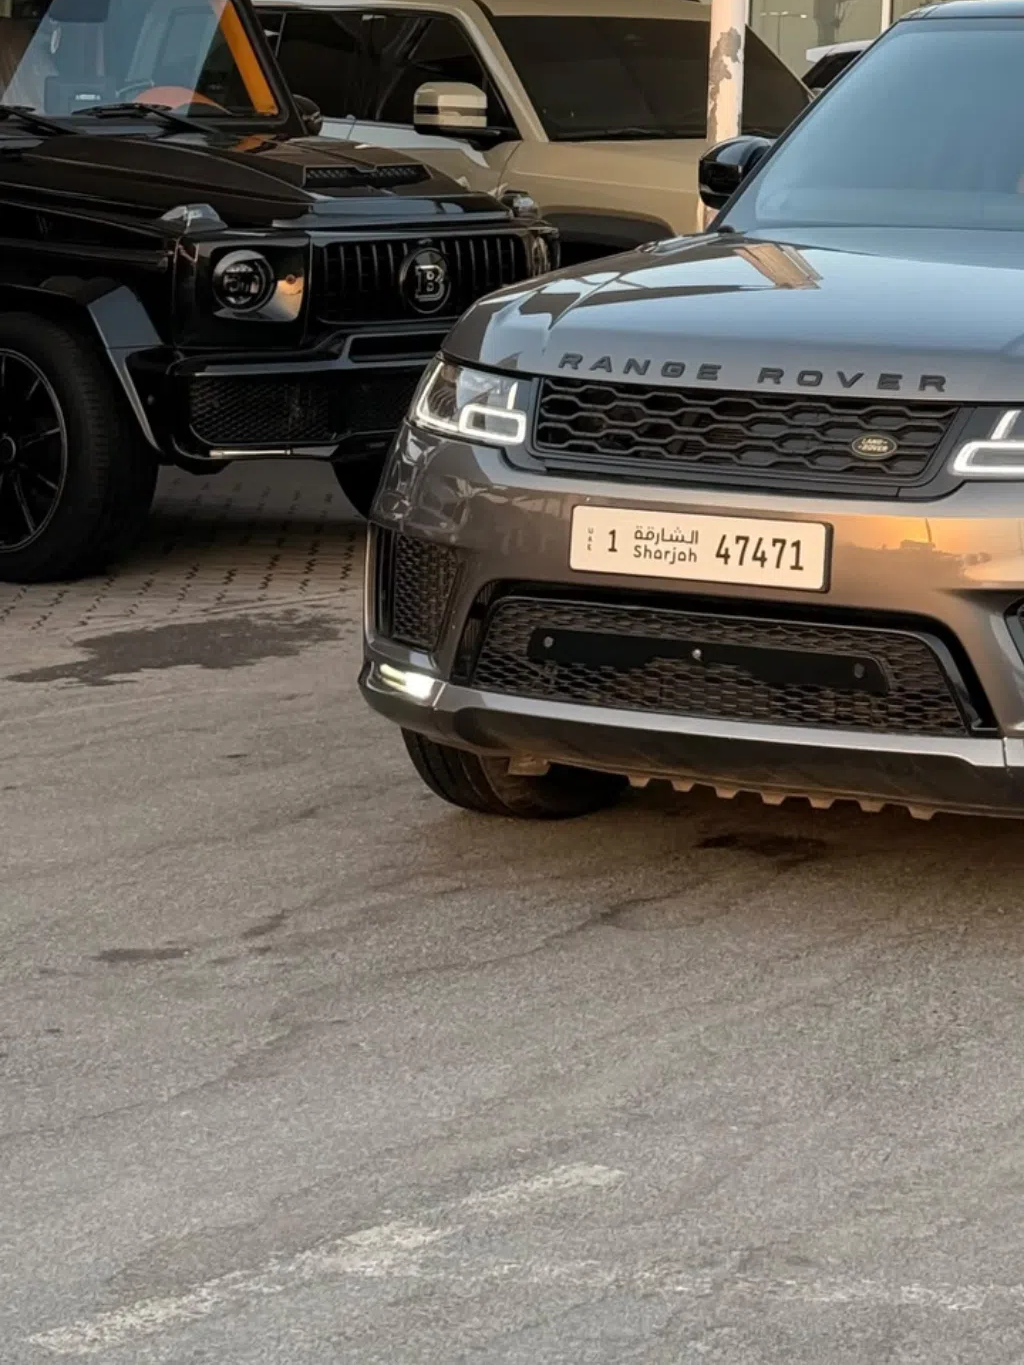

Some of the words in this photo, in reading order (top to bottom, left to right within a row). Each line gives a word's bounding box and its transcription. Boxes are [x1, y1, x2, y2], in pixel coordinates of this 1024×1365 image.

[558, 353, 722, 381] RANGE
[757, 367, 947, 392] ROVER
[608, 529, 618, 552] 1
[634, 525, 699, 545] الشارقة
[633, 544, 698, 565] Sharjah
[715, 534, 804, 571] 47471
